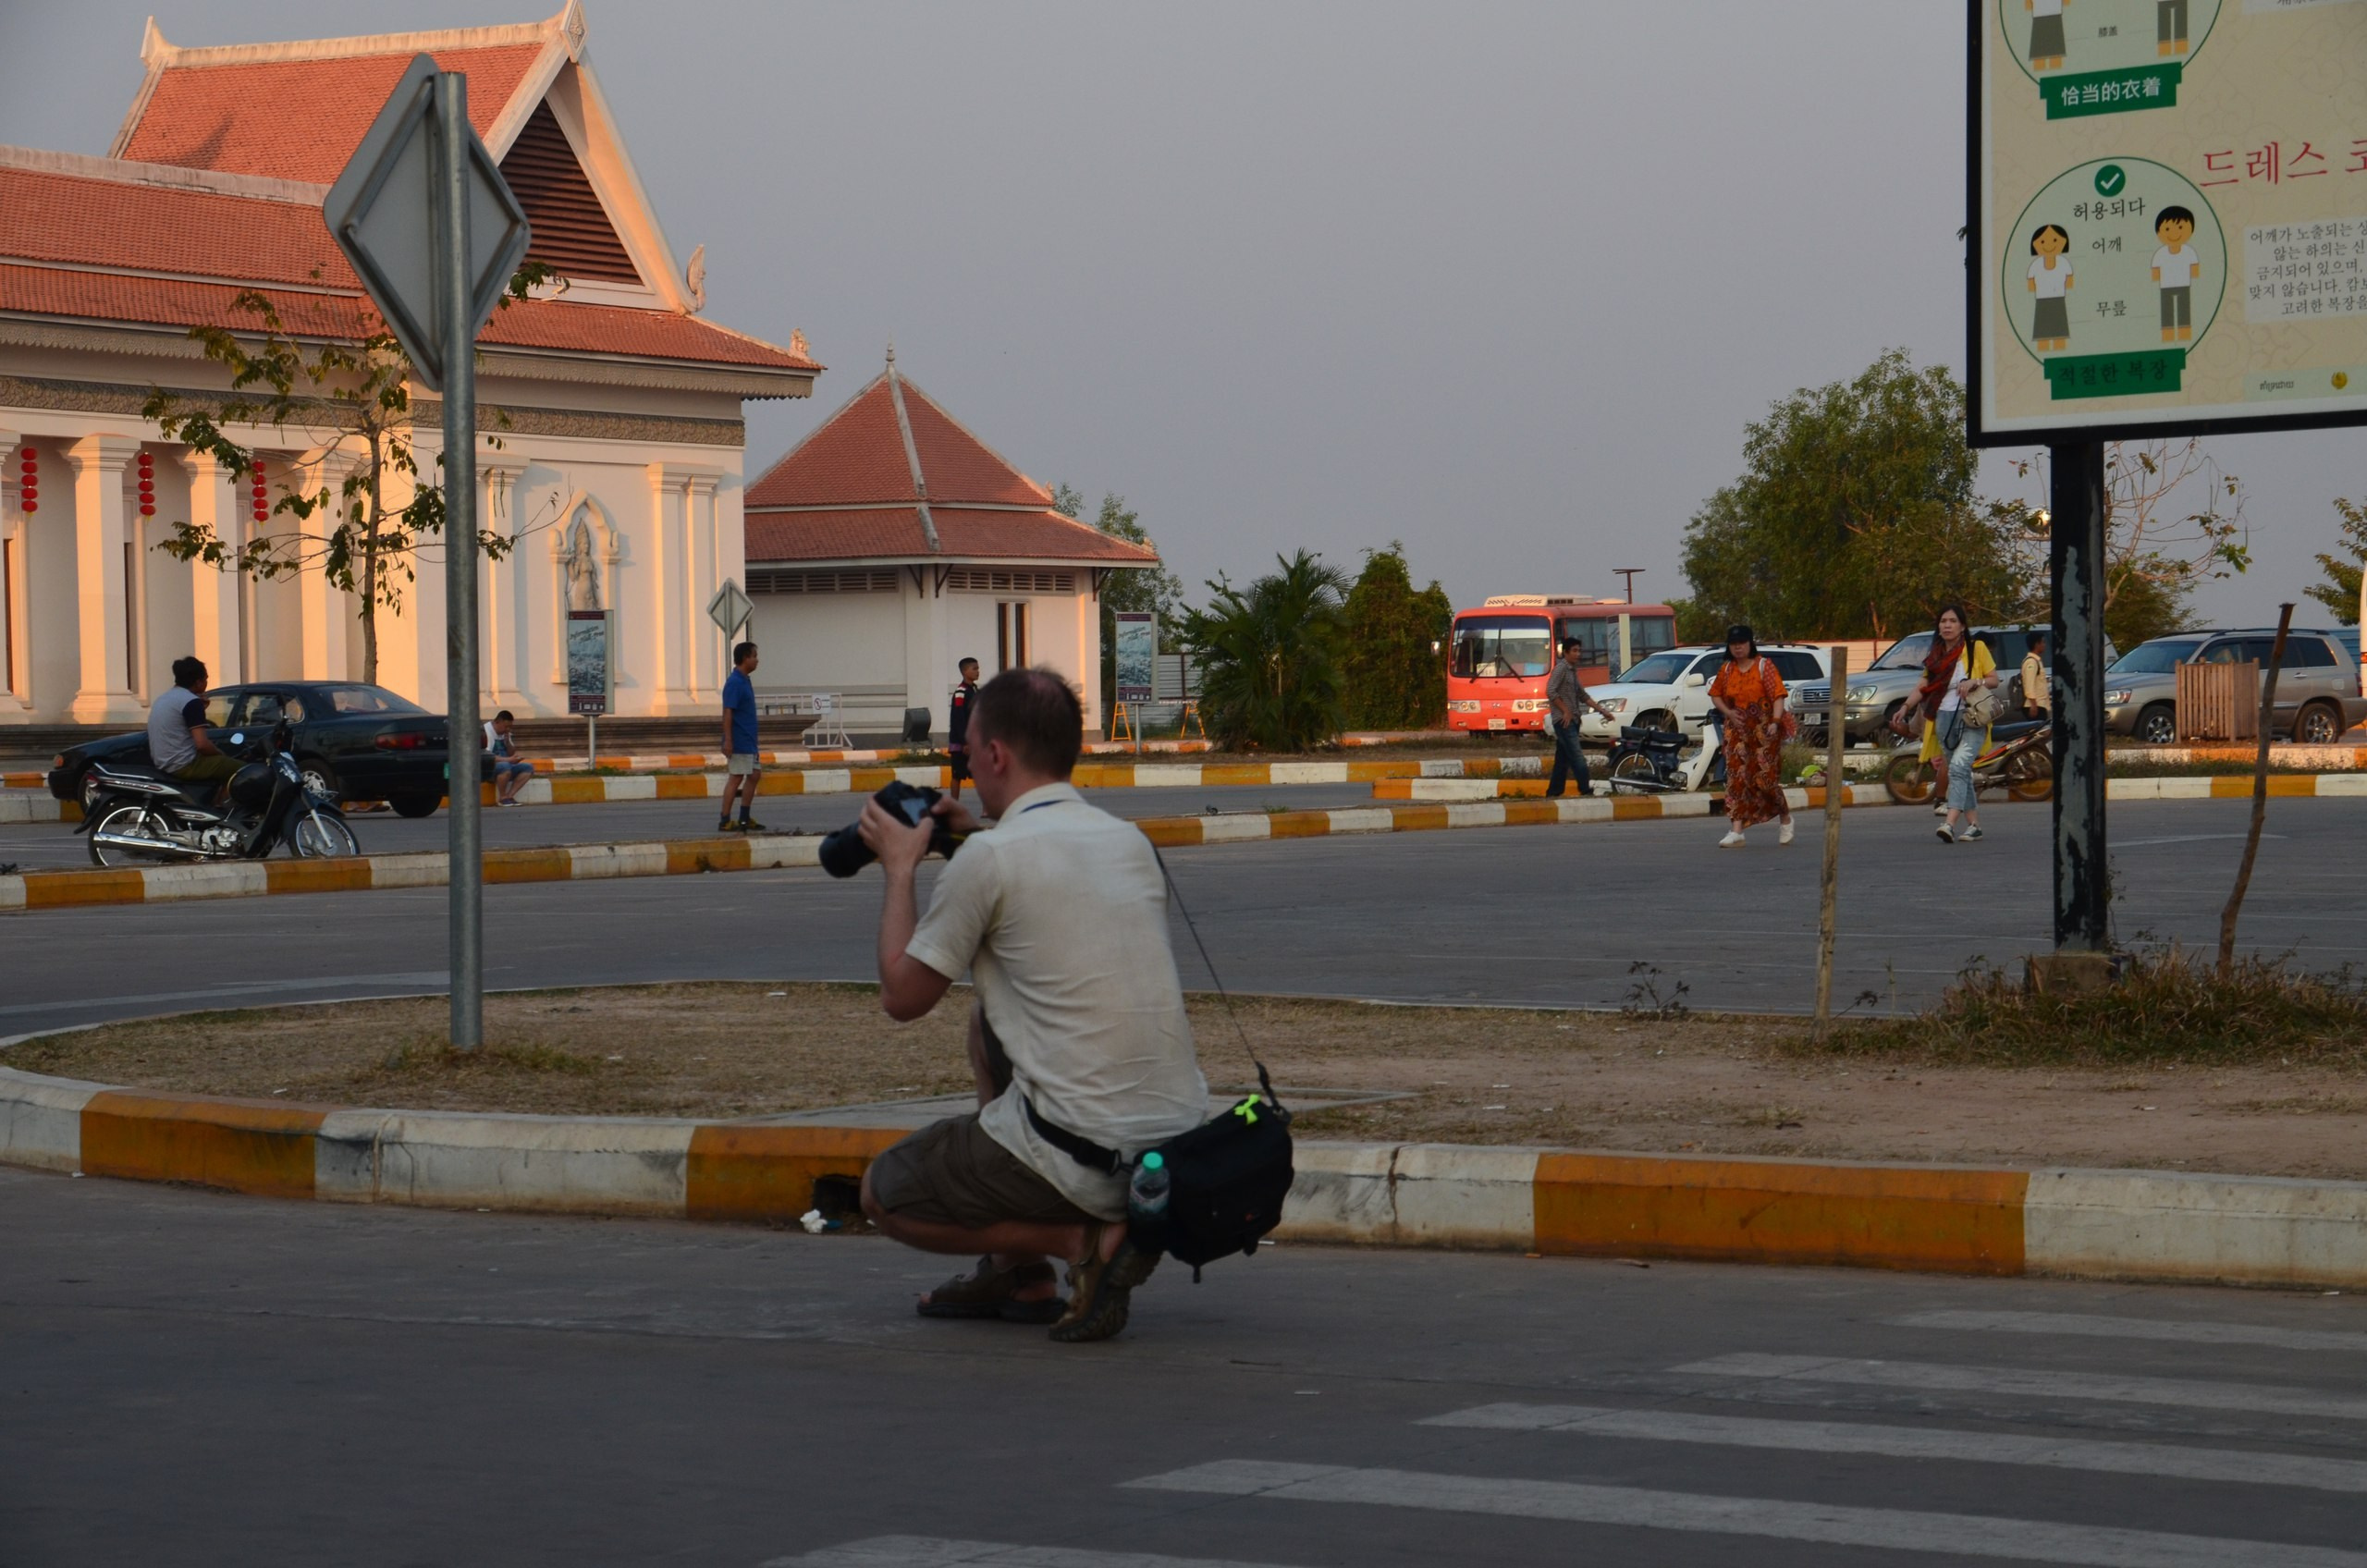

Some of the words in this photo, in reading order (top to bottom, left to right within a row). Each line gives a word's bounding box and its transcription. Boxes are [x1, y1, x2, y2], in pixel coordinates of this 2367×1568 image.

[2061, 76, 2161, 106] 恰当的衣着
[2200, 141, 2327, 187] 드레스
[2073, 197, 2146, 222] 허용되다
[2091, 236, 2122, 254] 어깨
[2250, 227, 2292, 245] 어깨가
[2296, 223, 2353, 240] 노출되는
[2305, 241, 2348, 259] 하의는
[2256, 262, 2311, 281] 금지되어
[2250, 283, 2275, 300] 맞지
[2281, 277, 2342, 298] 않습니다.
[2095, 300, 2128, 318] 무릎
[2281, 298, 2324, 315] 고려한
[2127, 358, 2168, 382] 복장
